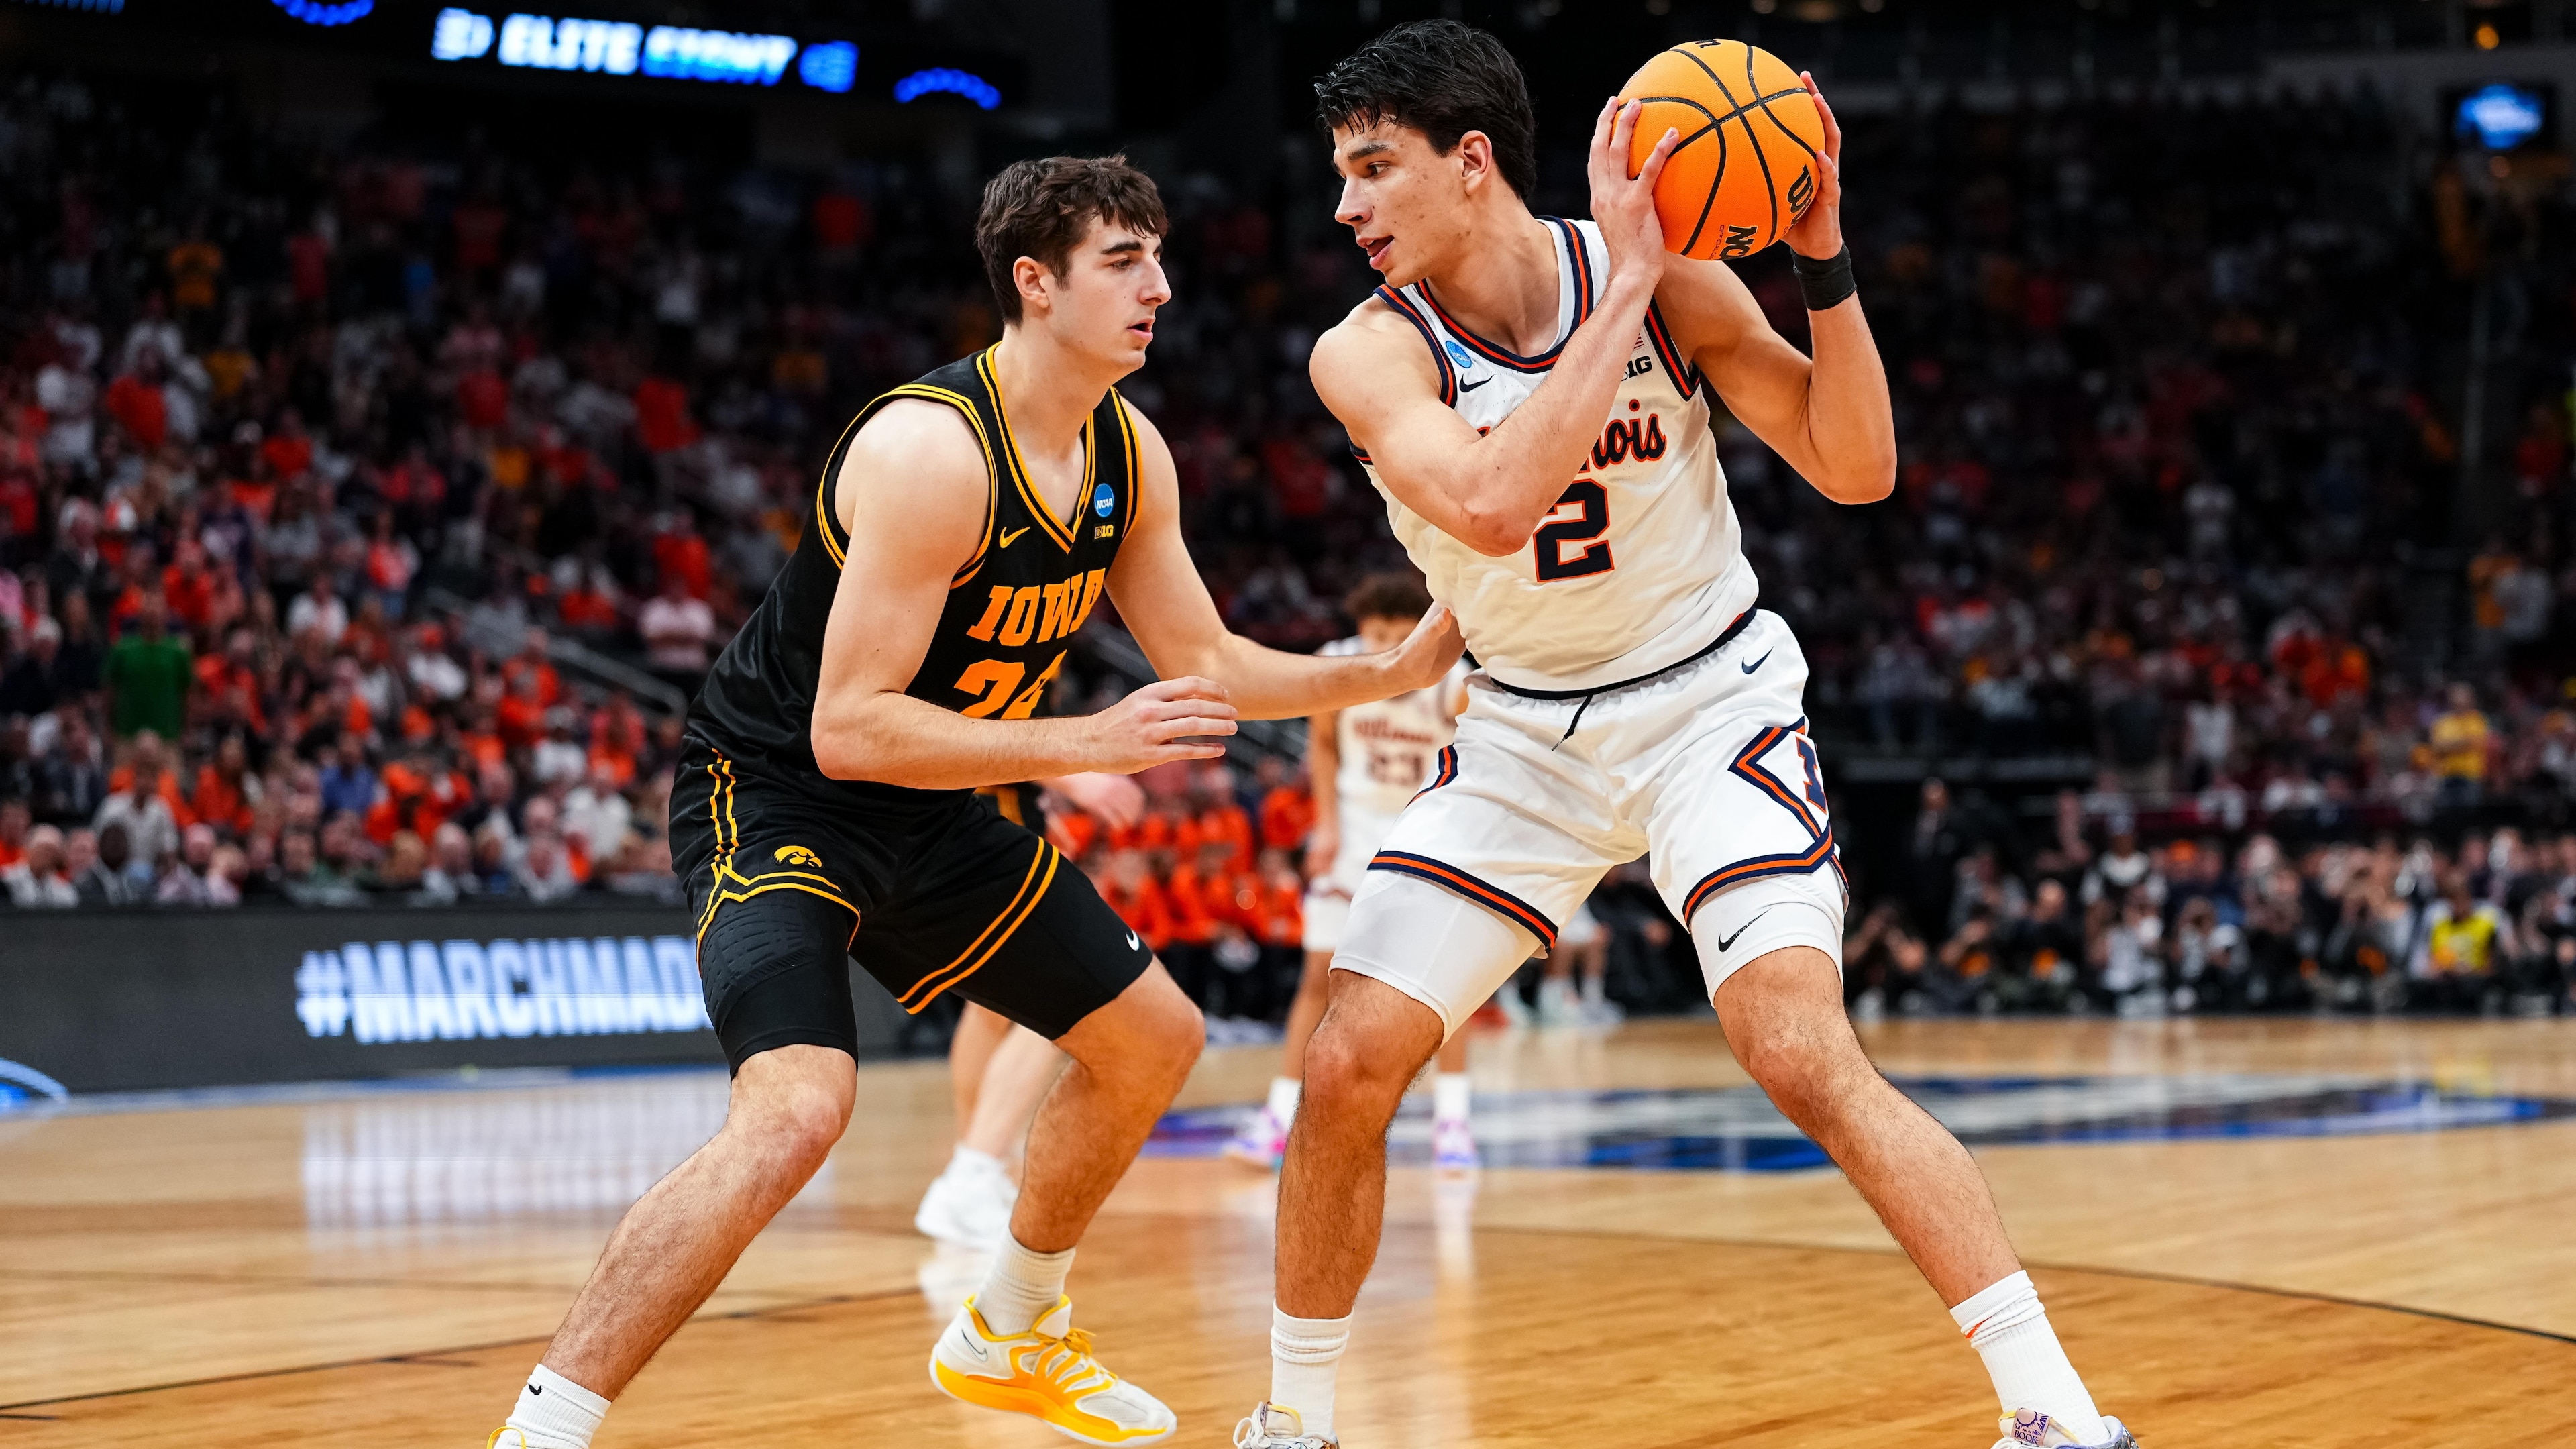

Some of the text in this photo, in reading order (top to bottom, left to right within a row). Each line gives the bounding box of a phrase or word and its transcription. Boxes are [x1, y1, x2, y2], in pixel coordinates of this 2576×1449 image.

[1097, 498, 1113, 509] NCAA
[1533, 478, 1615, 582] 2
[2014, 1430, 2038, 1445] BOOK
